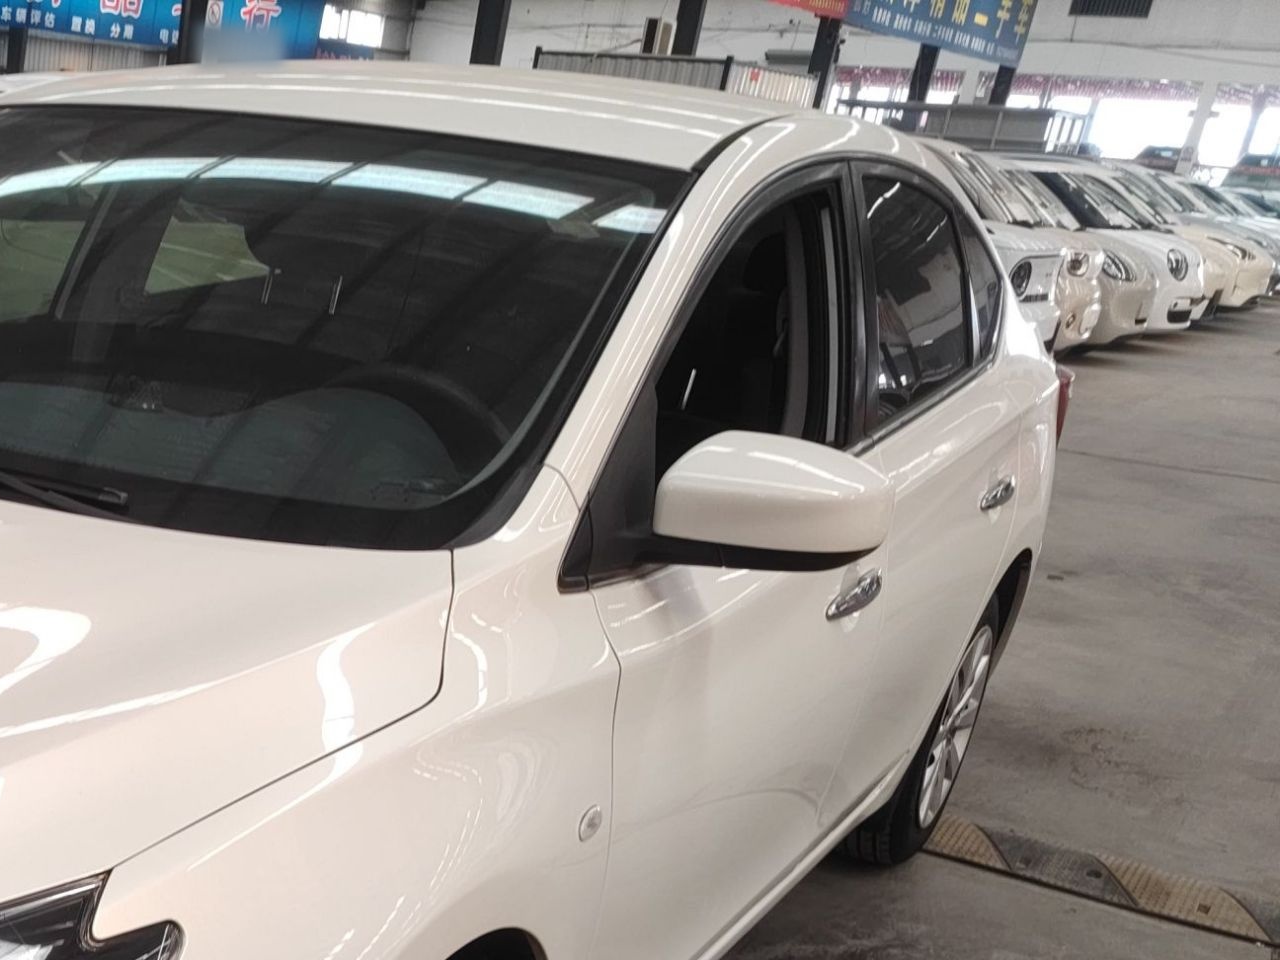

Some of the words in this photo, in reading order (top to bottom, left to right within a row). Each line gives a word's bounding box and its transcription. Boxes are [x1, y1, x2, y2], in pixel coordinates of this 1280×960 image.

[0, 6, 56, 28] 车辆评估
[70, 15, 96, 35] 置换
